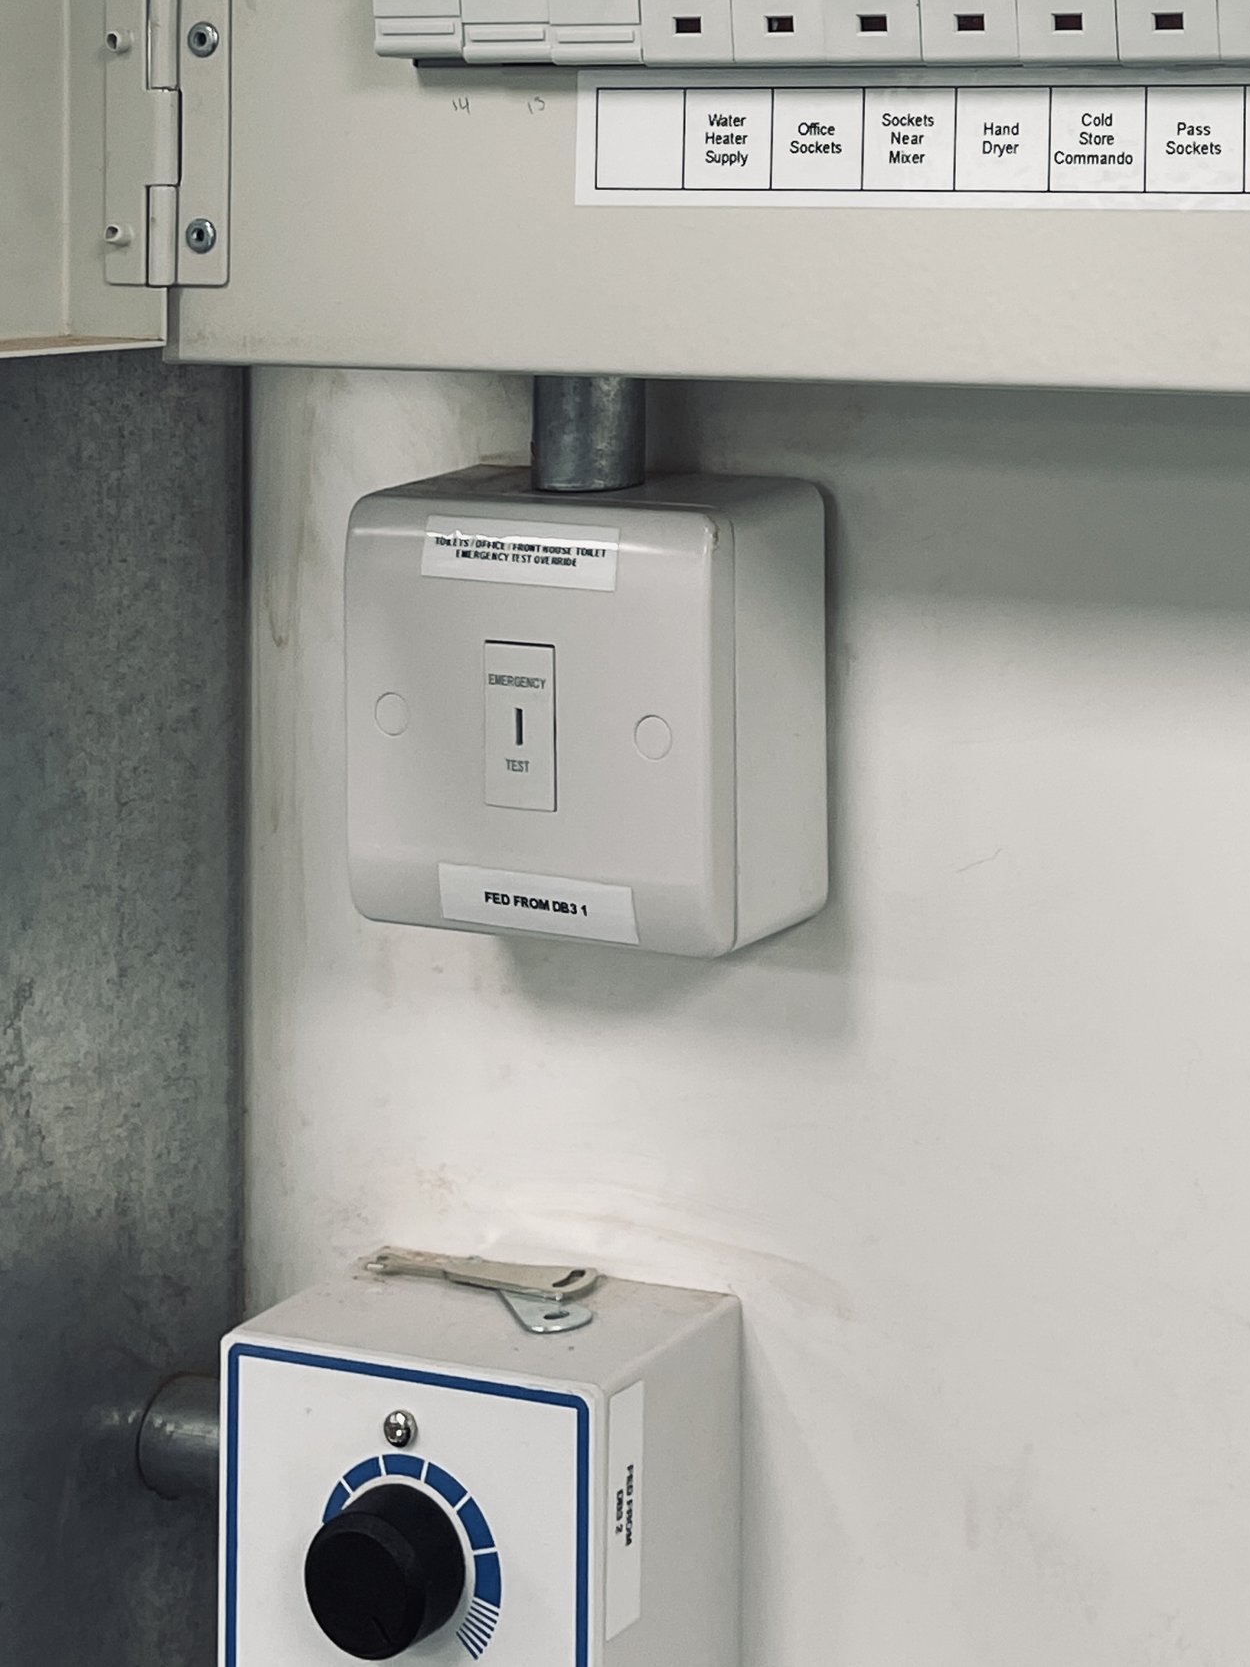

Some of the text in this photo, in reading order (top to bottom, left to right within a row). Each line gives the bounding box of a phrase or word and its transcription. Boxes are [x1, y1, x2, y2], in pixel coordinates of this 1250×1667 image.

[708, 114, 746, 127] Water
[882, 113, 935, 127] Sockets
[1081, 113, 1112, 127] Cold
[797, 122, 835, 136] Office
[983, 122, 1020, 136] Hand
[1177, 122, 1211, 136] Pass
[705, 132, 748, 145] Heater
[890, 132, 924, 145] Near
[1079, 132, 1114, 146] Store
[789, 141, 842, 154] Sockets
[982, 141, 1019, 157] Dryer
[1166, 141, 1222, 155] Sockets
[705, 151, 748, 167] Supply
[889, 151, 925, 164] Mixer
[1054, 151, 1134, 165] Commando
[435, 536, 469, 547] TOILETS
[512, 543, 540, 553] FRONT
[543, 544, 571, 555] HOUSE
[576, 548, 606, 557] TOILET
[456, 550, 577, 567] EMERGENCY TEST OVERRIDE
[488, 673, 546, 690] EMERGENCY
[505, 758, 530, 773] TEST
[484, 891, 587, 916] FED FROM DB3 1
